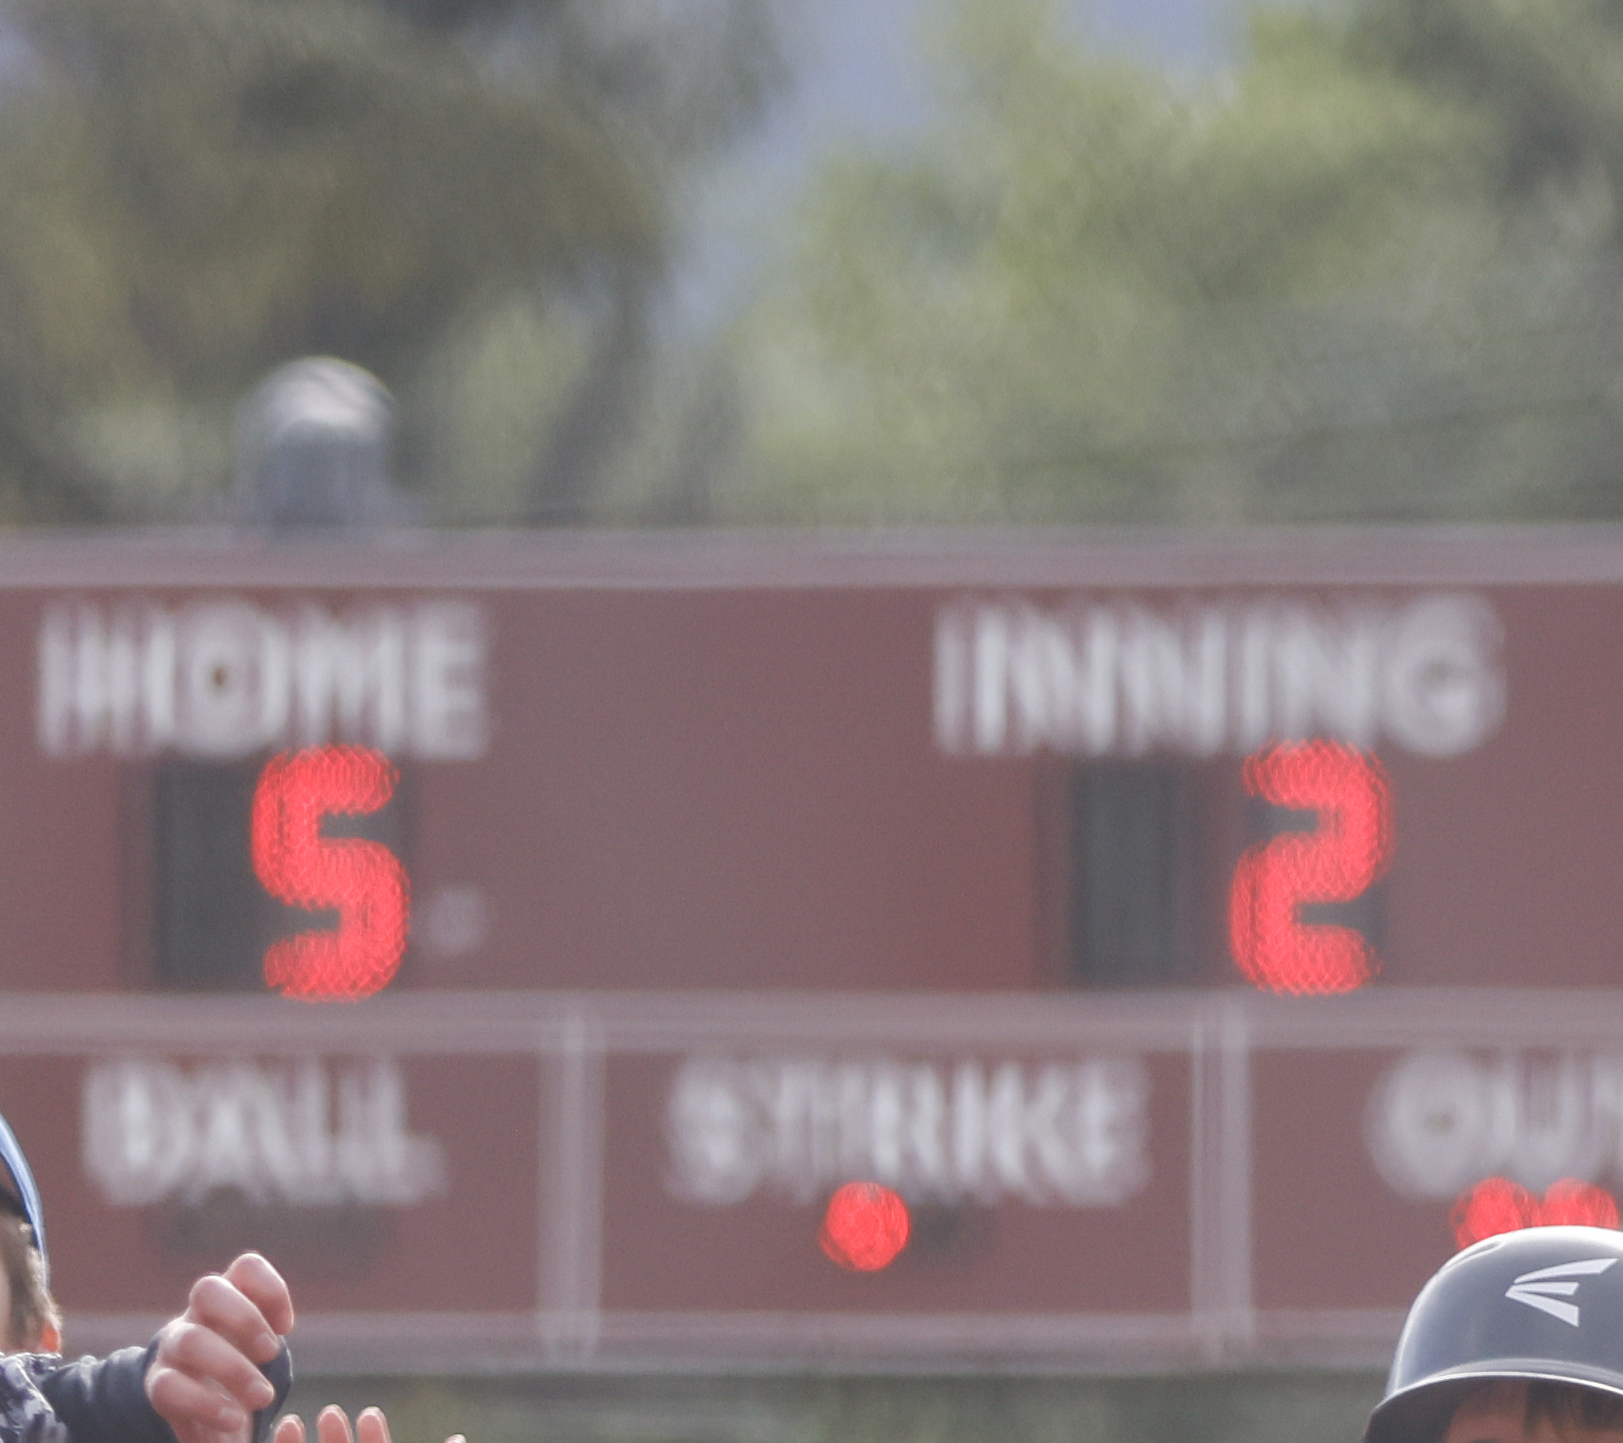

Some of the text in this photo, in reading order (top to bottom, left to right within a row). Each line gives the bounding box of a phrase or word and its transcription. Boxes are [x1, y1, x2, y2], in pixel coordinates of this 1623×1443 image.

[37, 602, 489, 756] HOME
[932, 600, 1505, 756] INNING
[250, 745, 410, 998] 5
[1229, 740, 1391, 996] 2
[81, 1058, 445, 1200] BALL
[667, 1054, 1151, 1202] STRIKE
